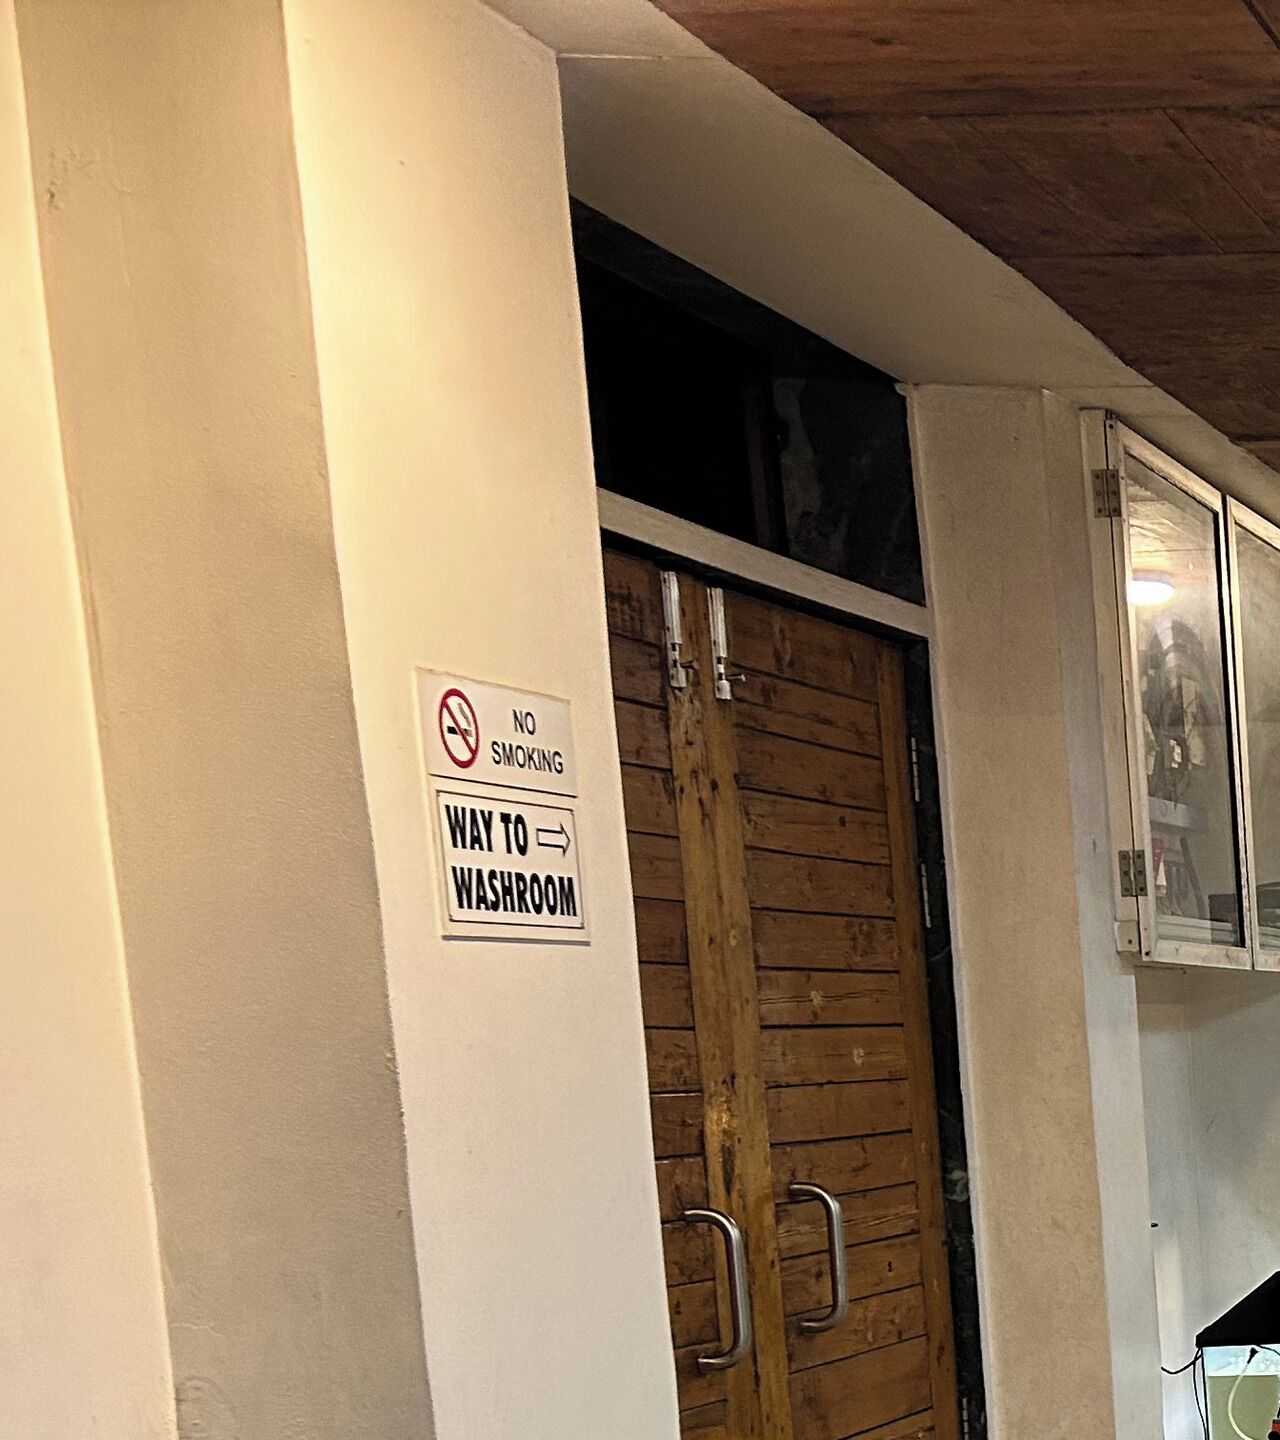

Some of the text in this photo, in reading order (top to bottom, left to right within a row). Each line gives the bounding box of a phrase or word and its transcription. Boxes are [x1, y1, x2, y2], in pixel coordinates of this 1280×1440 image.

[512, 708, 536, 736] NO
[491, 740, 564, 775] SMOKING
[445, 804, 529, 857] WAY TO
[450, 865, 578, 917] WASHROOM
